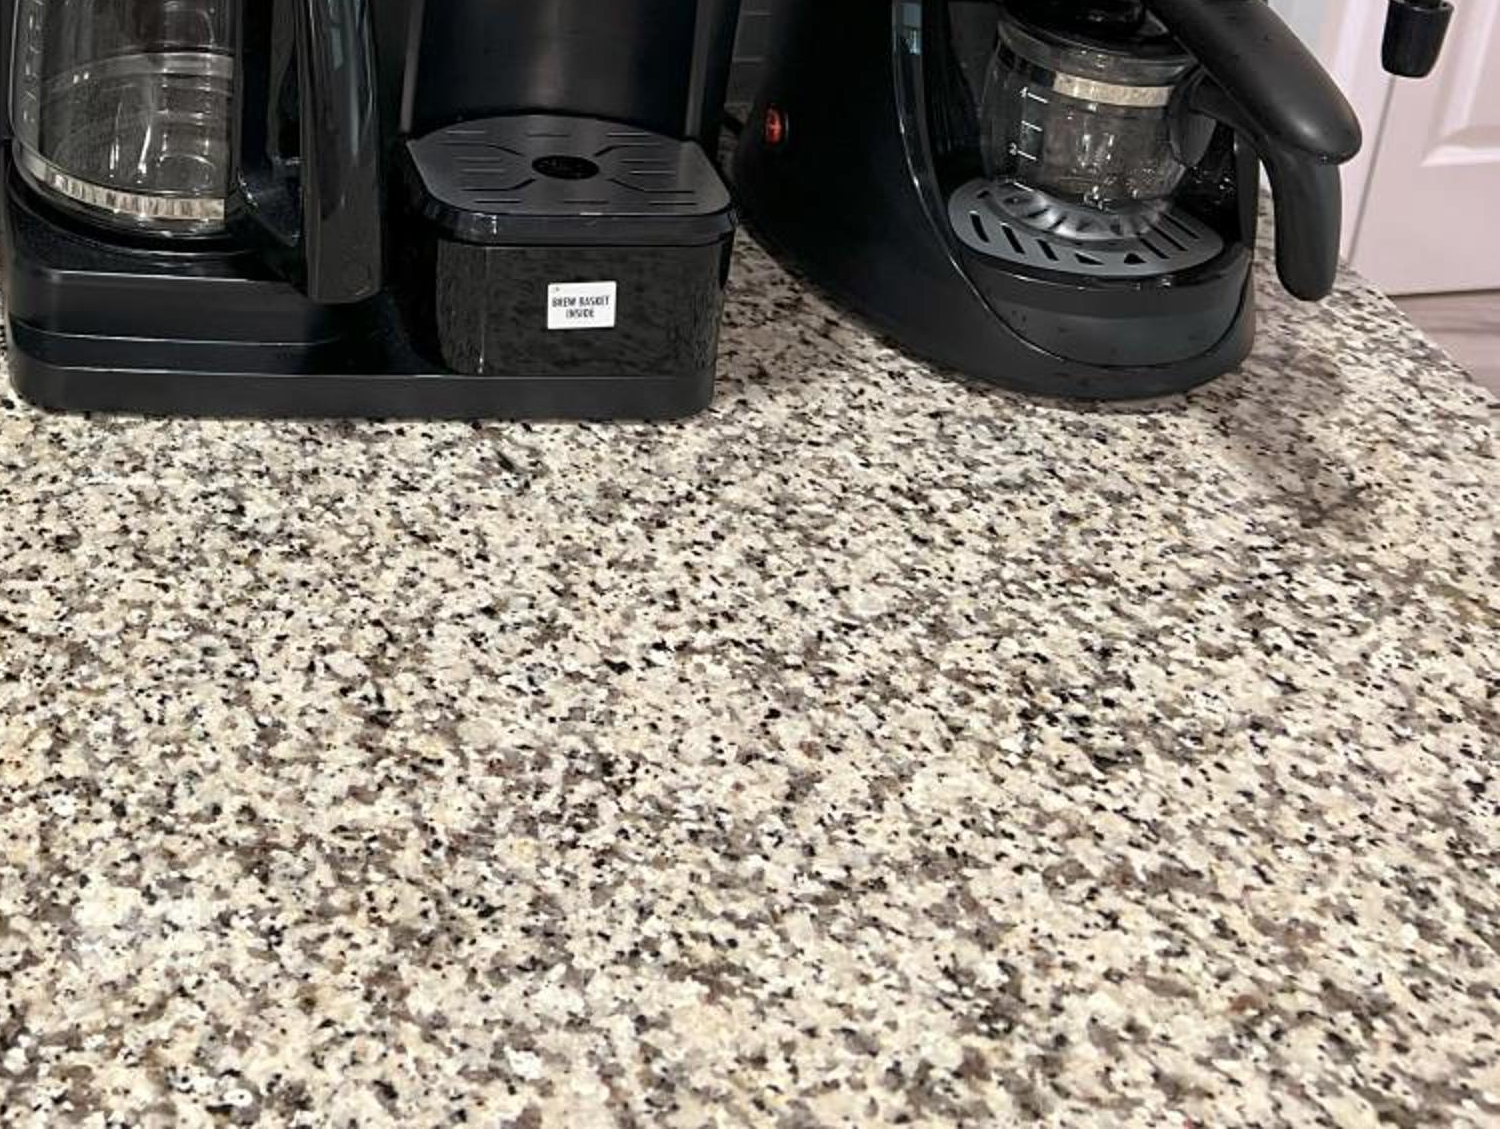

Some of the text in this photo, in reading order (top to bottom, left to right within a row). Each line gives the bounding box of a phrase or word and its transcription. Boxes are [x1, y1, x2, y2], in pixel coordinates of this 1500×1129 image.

[553, 295, 610, 308] BREW BASKET
[565, 309, 596, 319] INSIDE
